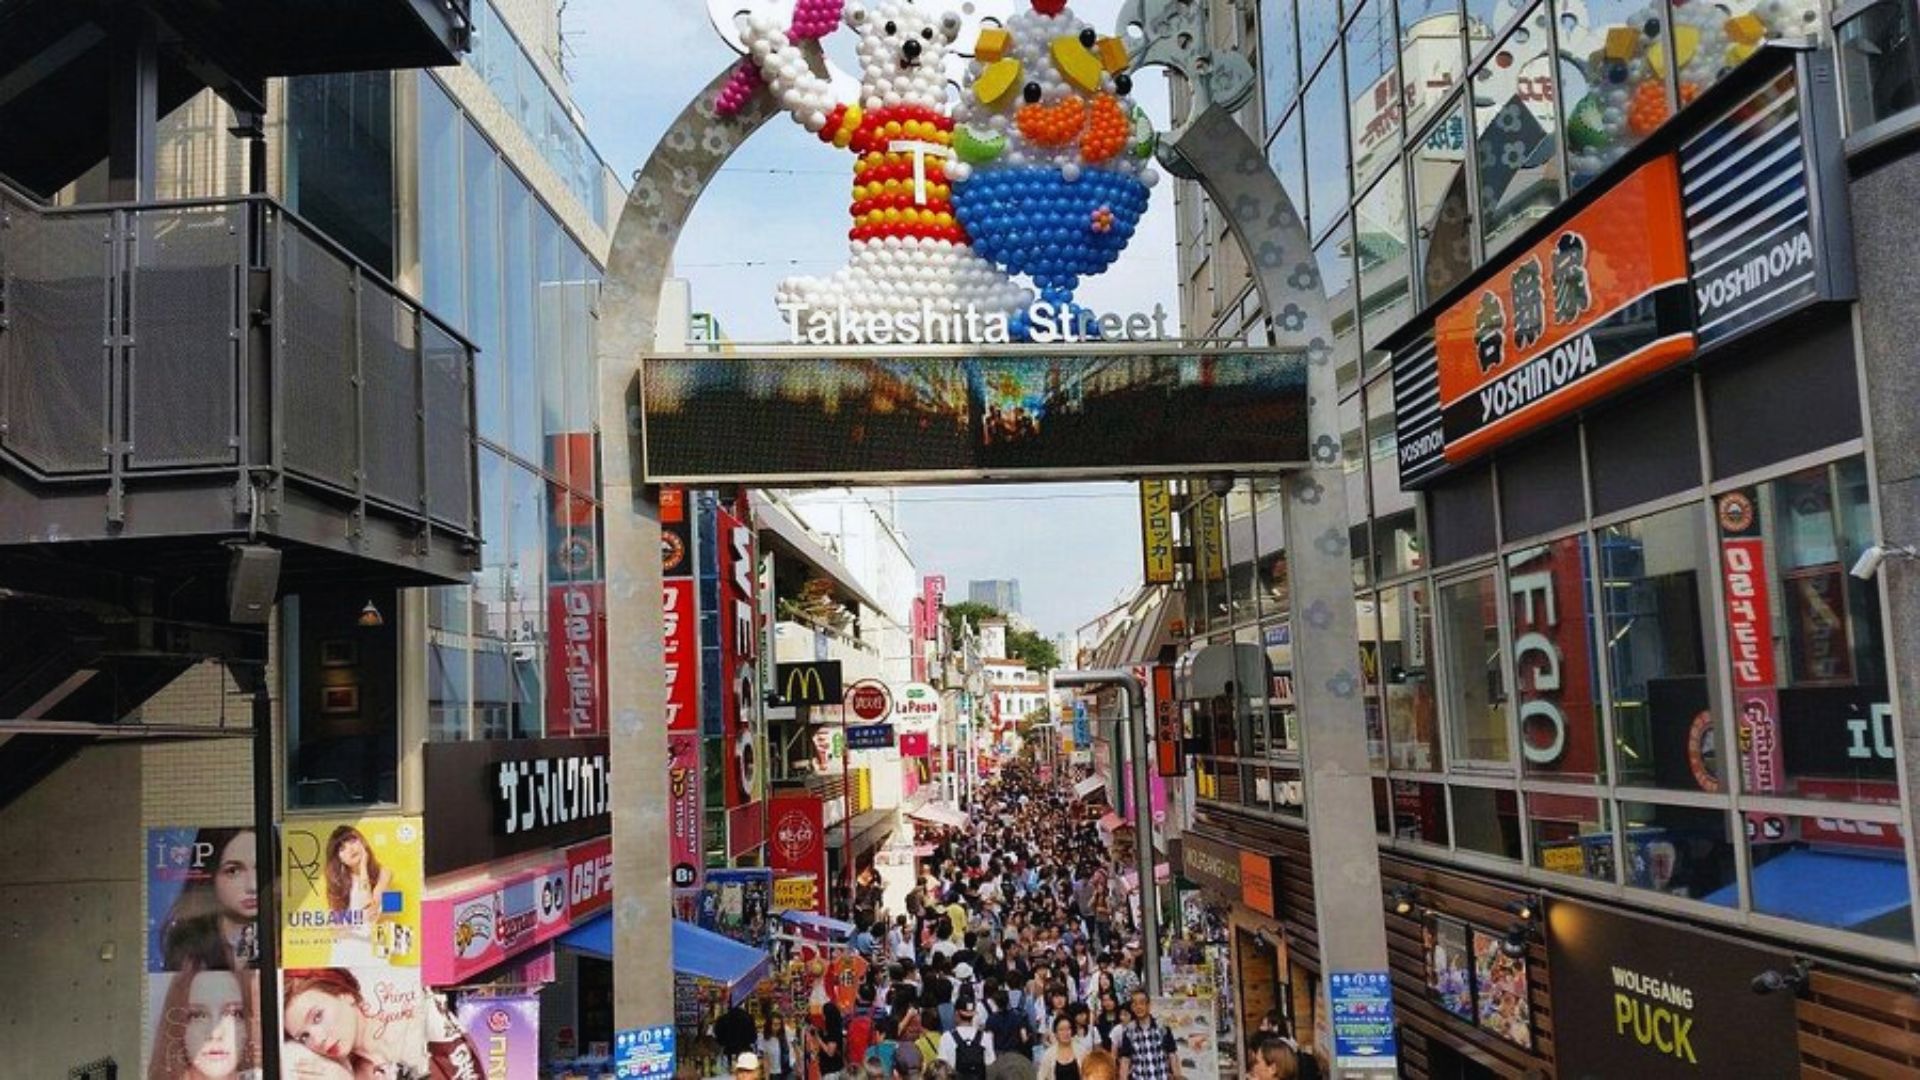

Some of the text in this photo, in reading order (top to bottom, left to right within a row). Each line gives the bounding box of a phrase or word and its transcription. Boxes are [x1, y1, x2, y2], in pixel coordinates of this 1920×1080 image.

[889, 140, 950, 205] T
[1696, 231, 1813, 316] YOSHINOYA
[780, 302, 1170, 344] Takeshita Street
[1480, 334, 1597, 423] YOSHINOYA
[1612, 966, 1694, 1010] WOLFGANG
[1615, 993, 1697, 1064] PUCK
